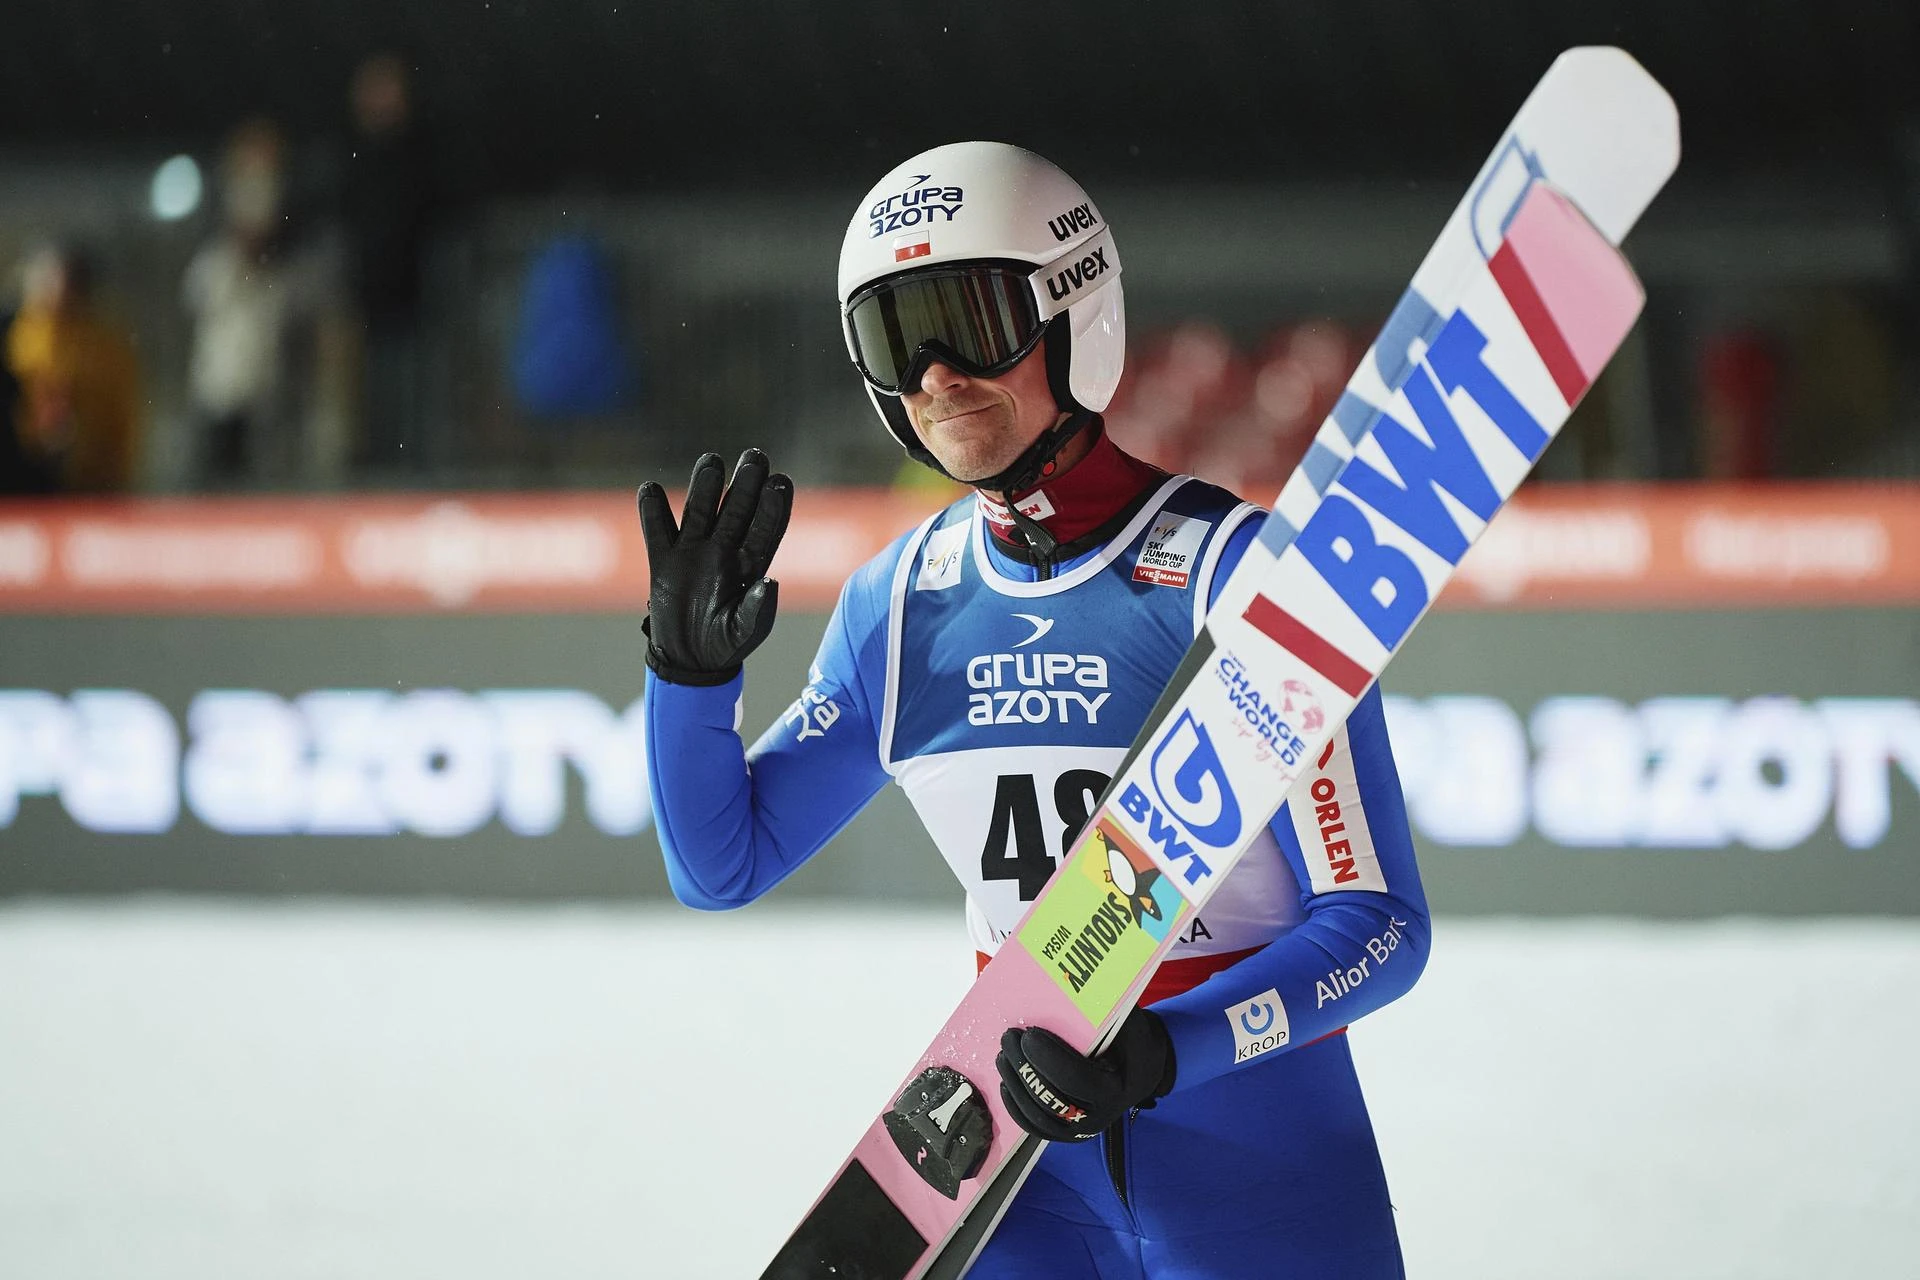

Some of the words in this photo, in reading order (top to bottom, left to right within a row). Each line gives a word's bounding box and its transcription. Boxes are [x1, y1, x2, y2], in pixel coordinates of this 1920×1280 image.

[1048, 202, 1098, 242] uvex
[1046, 246, 1109, 301] uvex
[1294, 308, 1551, 653] BWT
[1142, 556, 1168, 567] WORLD
[1168, 560, 1183, 569] CUP
[1144, 549, 1187, 563] JUMPING
[1147, 541, 1164, 551] SKI
[1219, 658, 1306, 757] CHANGE
[1229, 687, 1295, 766] WORLD
[1118, 781, 1213, 886] BWT
[1310, 778, 1360, 885] ORLEN
[1058, 891, 1132, 994] SKOLNITY
[1315, 956, 1371, 1010] Alior
[1237, 1031, 1287, 1060] KROP
